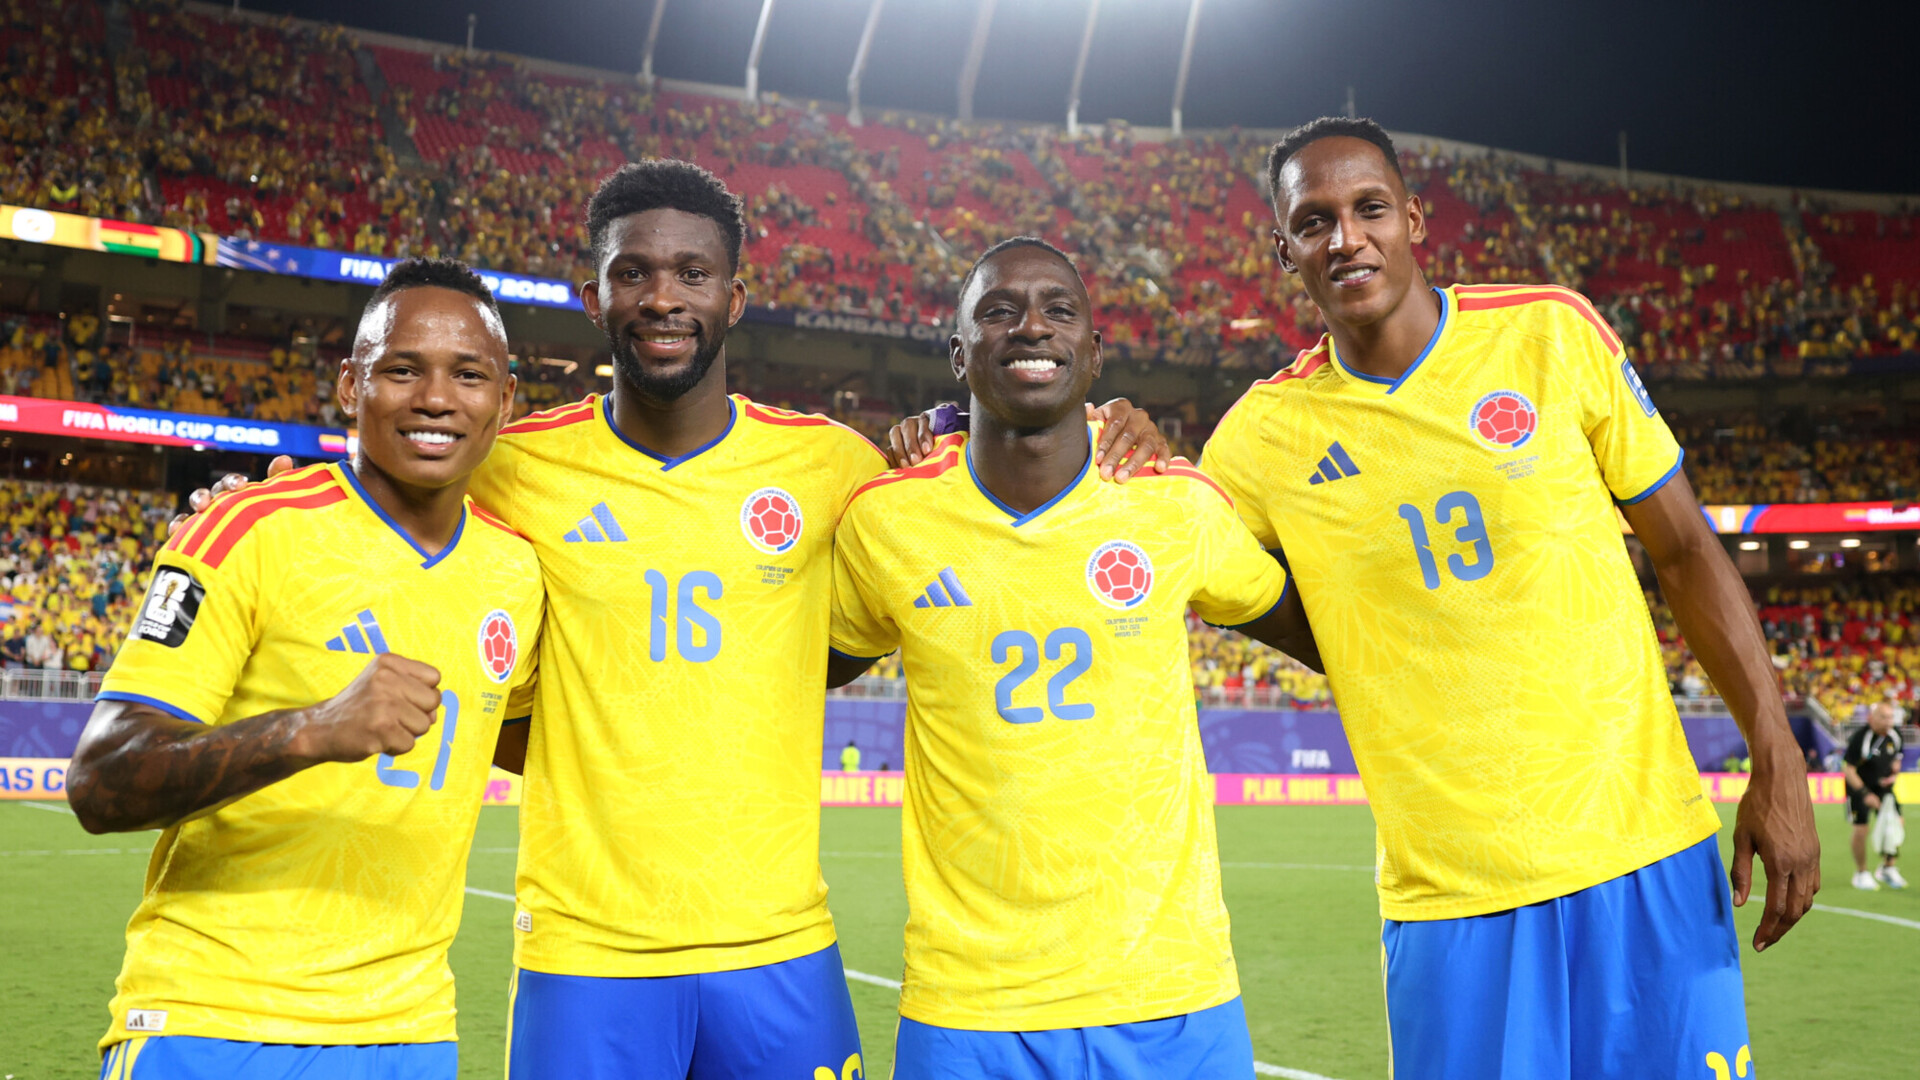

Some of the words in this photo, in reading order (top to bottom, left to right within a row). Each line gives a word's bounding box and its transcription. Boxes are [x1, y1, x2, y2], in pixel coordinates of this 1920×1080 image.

[340, 258, 385, 280] FIFA
[500, 279, 570, 303] 2026
[795, 313, 907, 338] KANSAS
[62, 410, 105, 430] FIFA
[106, 414, 175, 436] WORLD
[176, 421, 214, 439] CUP
[214, 424, 280, 446] 2026
[1398, 490, 1495, 590] 13
[644, 568, 723, 663] 16
[990, 627, 1095, 724] 22
[1292, 750, 1331, 769] FIFA
